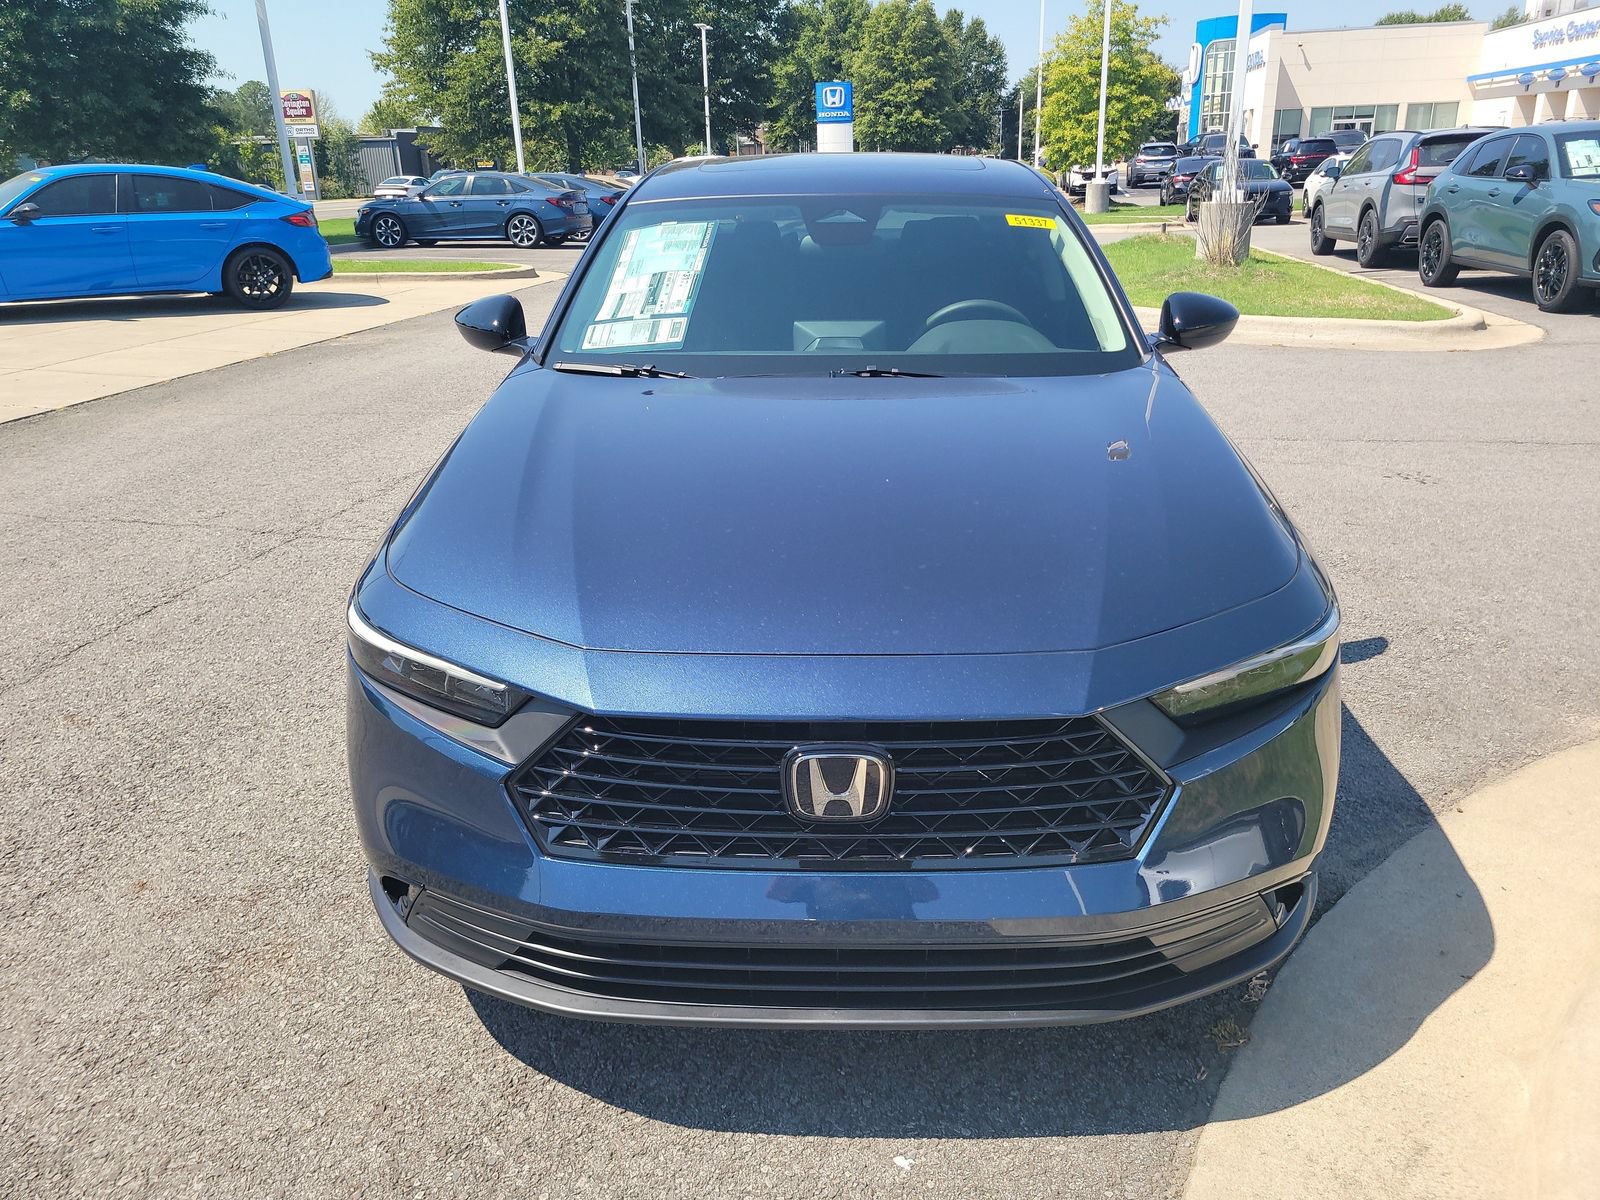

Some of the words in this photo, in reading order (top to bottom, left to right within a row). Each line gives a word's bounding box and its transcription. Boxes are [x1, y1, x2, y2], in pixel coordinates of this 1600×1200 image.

[1533, 26, 1565, 44] Service
[286, 107, 307, 117] Square
[1014, 216, 1048, 227] 51337
